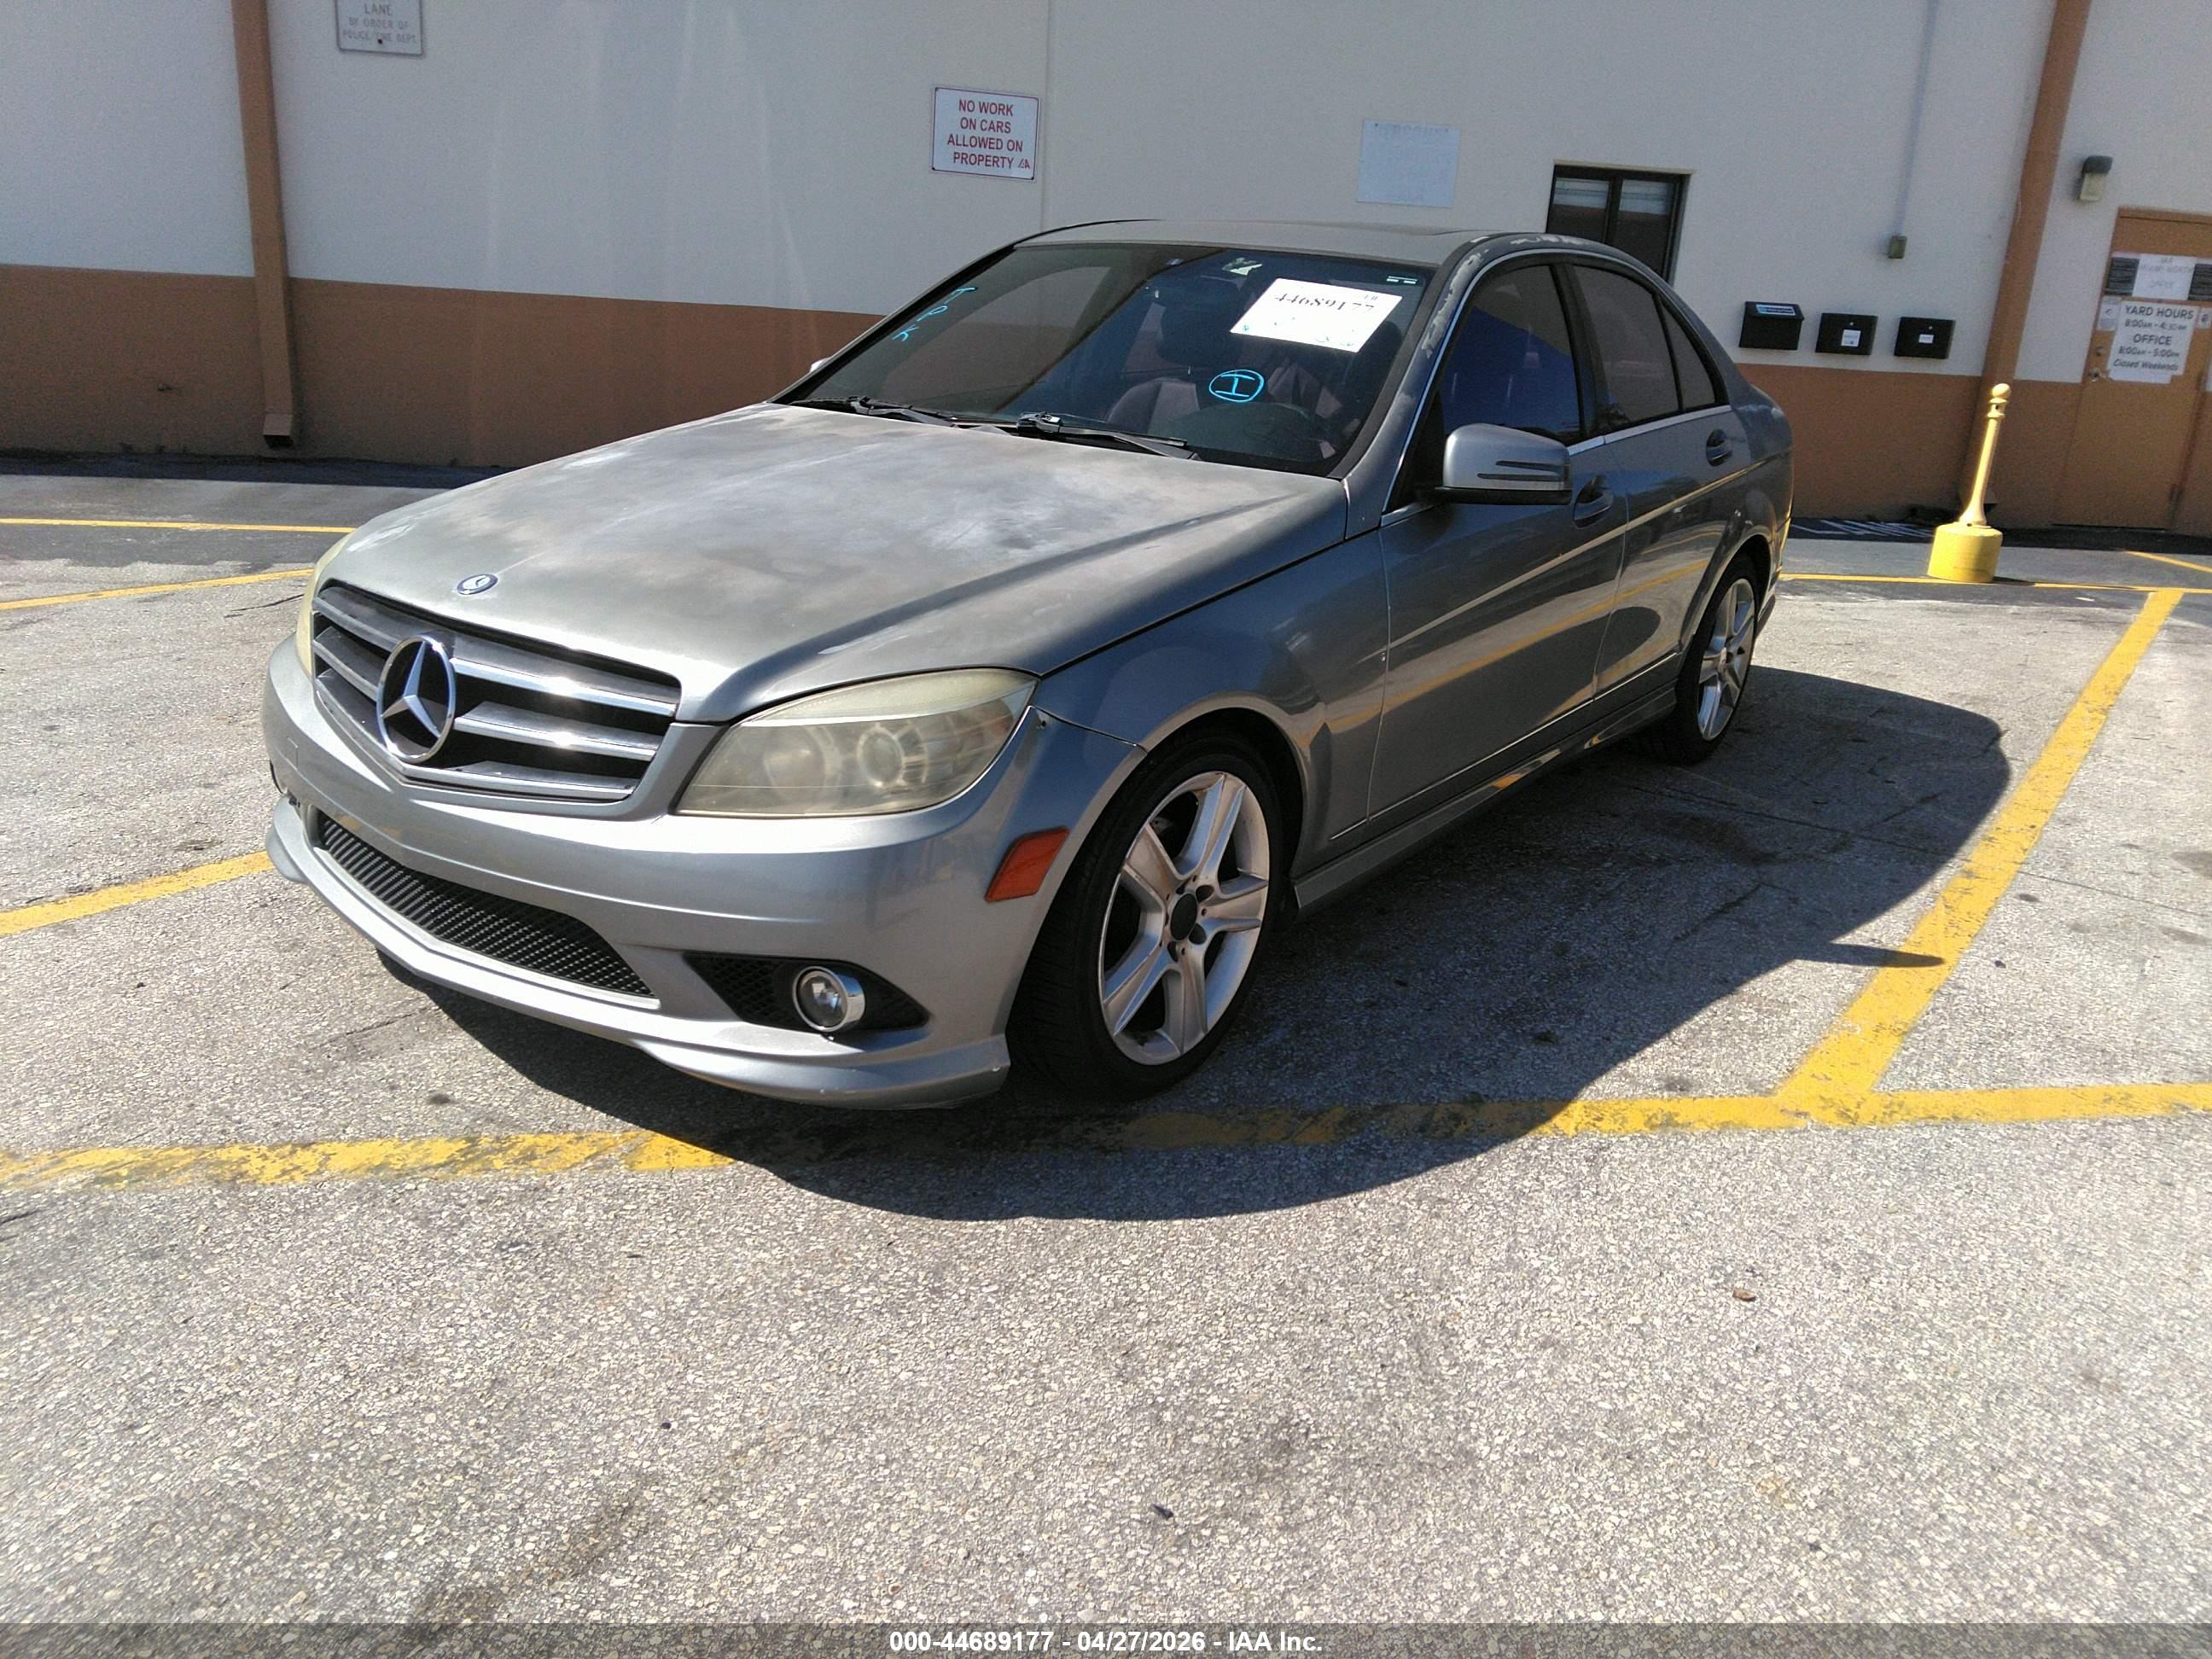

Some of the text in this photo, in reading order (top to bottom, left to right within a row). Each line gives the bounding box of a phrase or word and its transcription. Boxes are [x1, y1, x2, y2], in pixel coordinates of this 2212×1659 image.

[364, 3, 393, 15] LANE
[363, 19, 393, 29] ORDER
[958, 99, 1014, 116] NO WORK
[960, 117, 1011, 134] ON CARS
[946, 133, 1023, 153] ALLOWED ON
[953, 151, 1015, 169] PROPERTY
[2125, 306, 2194, 320] YARD HOURS
[2133, 334, 2172, 346] OFFICE
